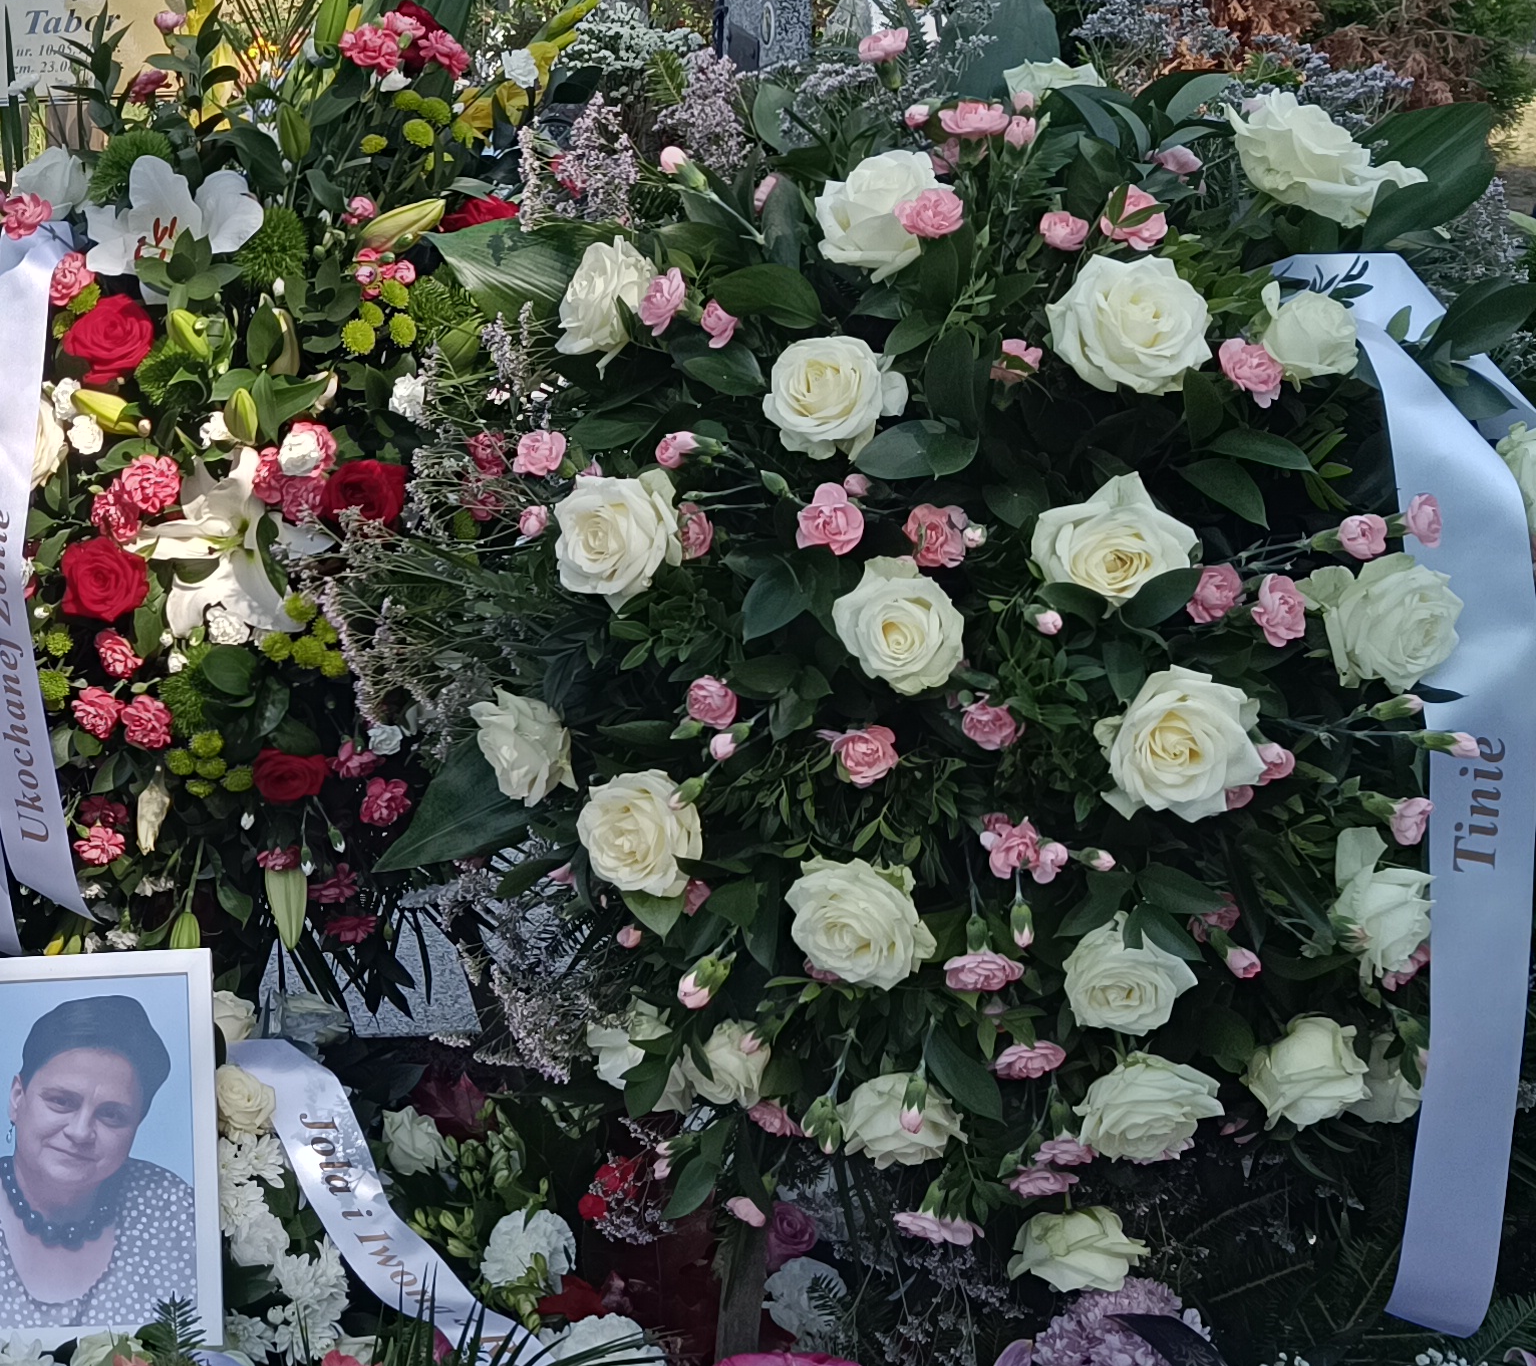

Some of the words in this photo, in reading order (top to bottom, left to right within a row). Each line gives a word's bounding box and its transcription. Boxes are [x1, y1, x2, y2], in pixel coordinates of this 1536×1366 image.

[16, 45, 32, 57] ur.
[1451, 734, 1508, 874] Tinie
[341, 1208, 373, 1221] i
